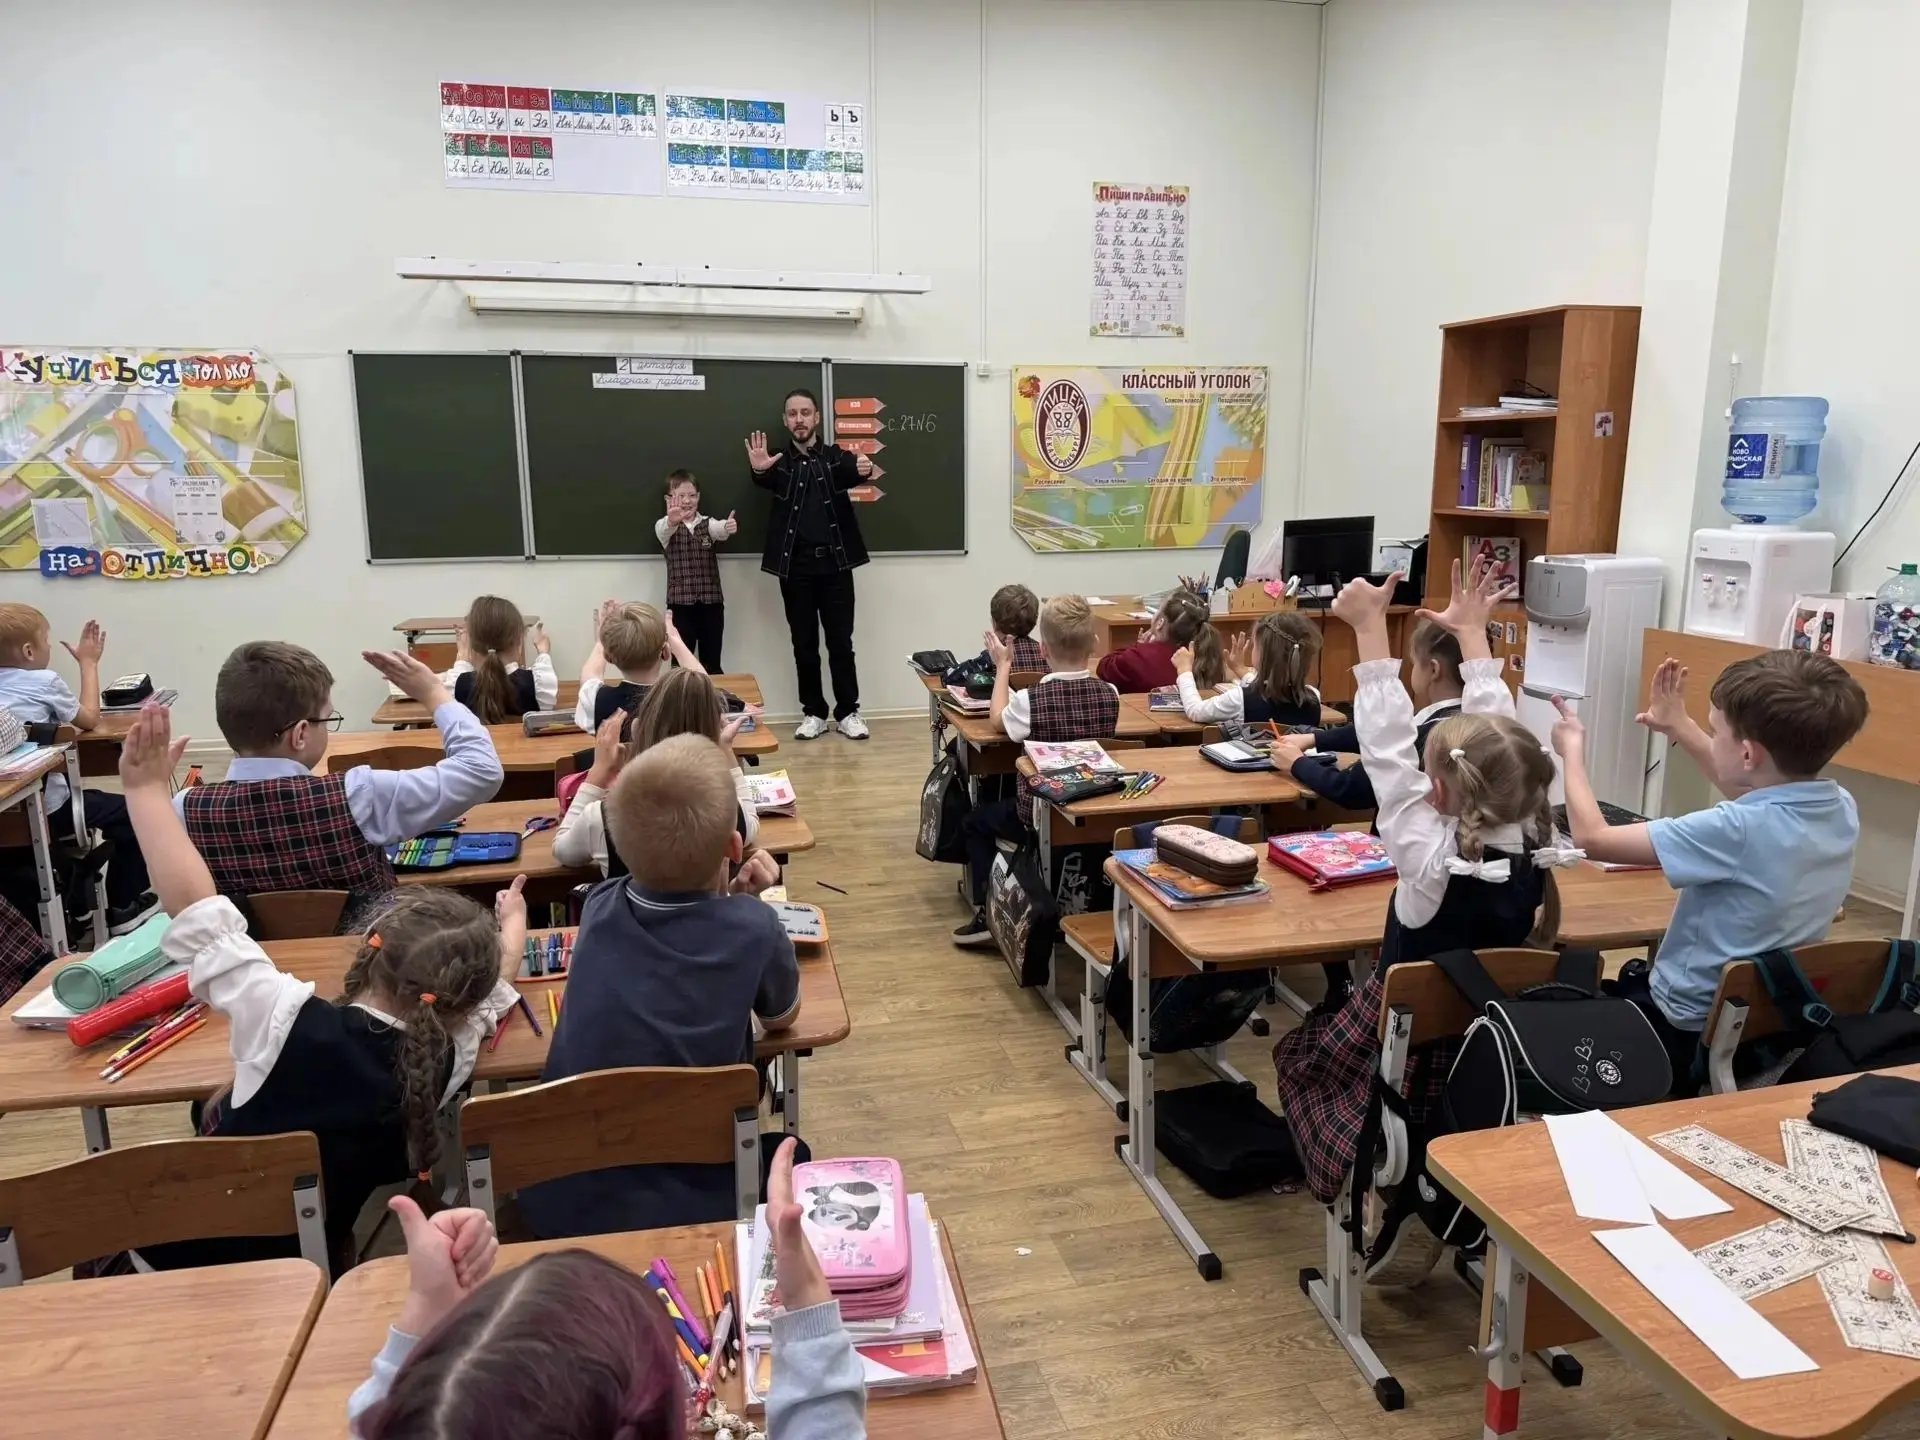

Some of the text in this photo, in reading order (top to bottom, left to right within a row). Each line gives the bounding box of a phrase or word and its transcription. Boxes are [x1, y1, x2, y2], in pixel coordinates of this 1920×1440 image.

[1122, 371, 1252, 389] КЛАССНЫЙ УГОЛОК
[1053, 412, 1073, 428] 88
[1769, 439, 1780, 474] ПРЕМИУМ
